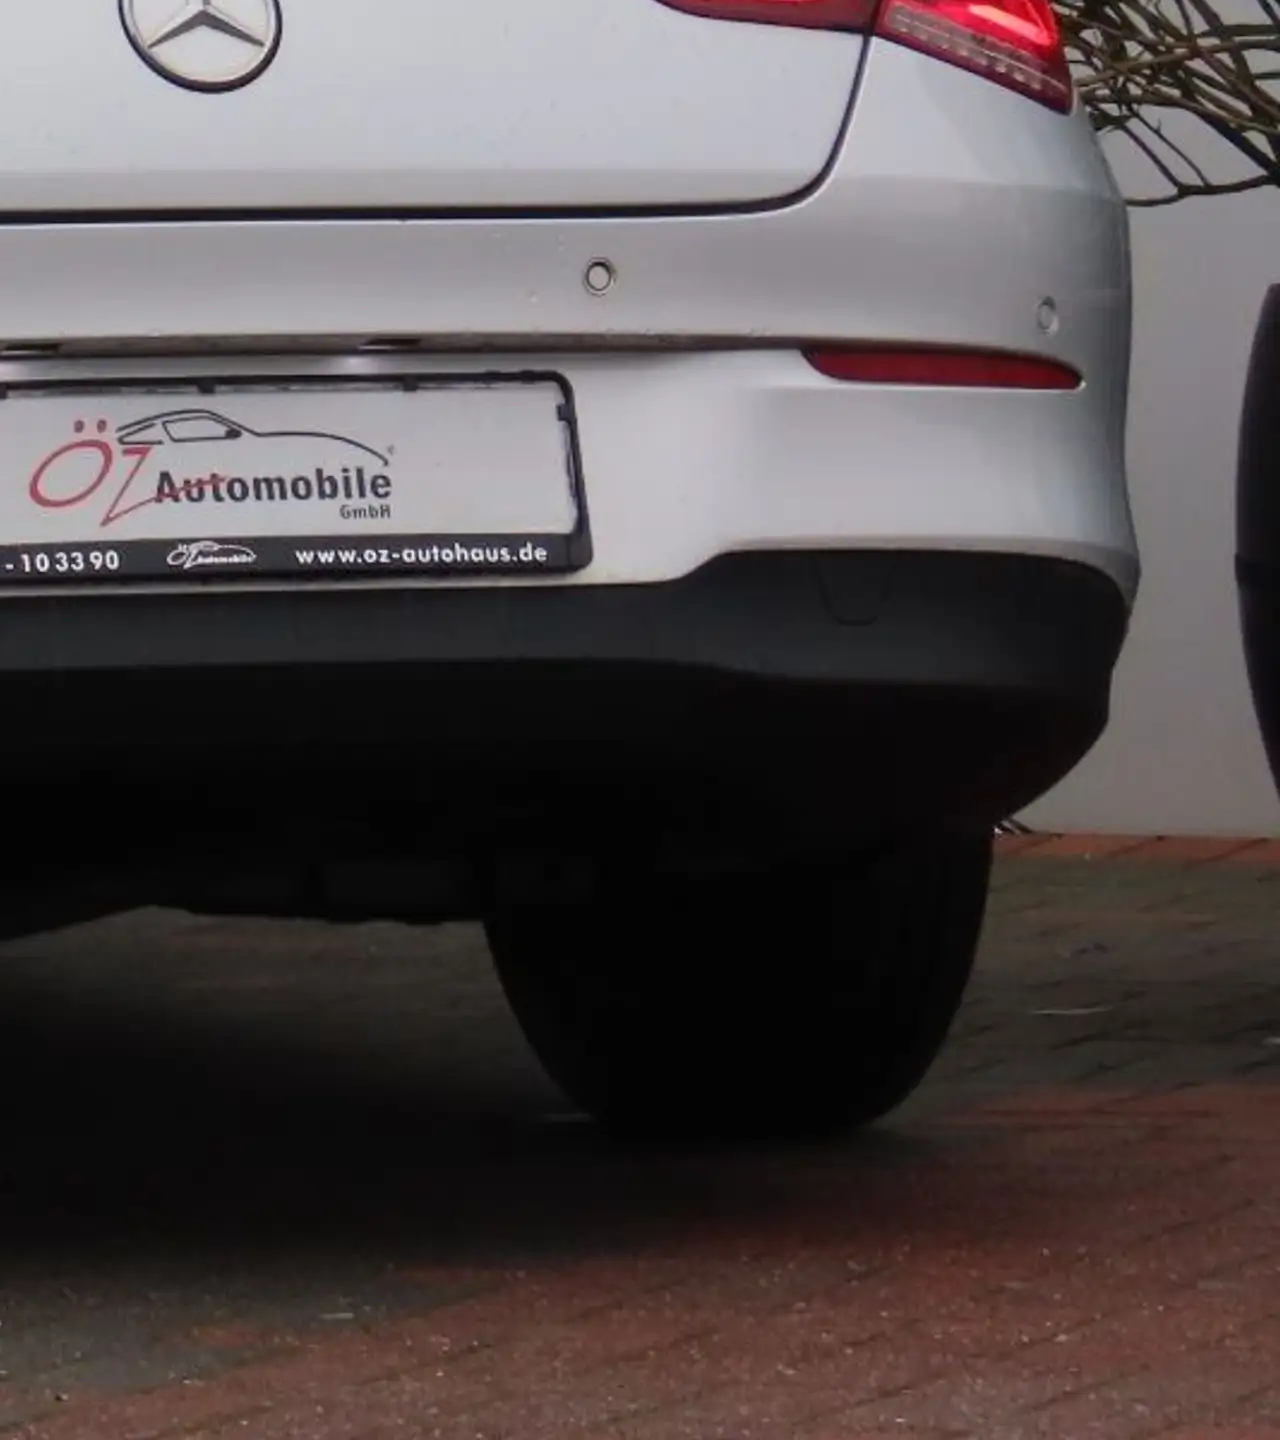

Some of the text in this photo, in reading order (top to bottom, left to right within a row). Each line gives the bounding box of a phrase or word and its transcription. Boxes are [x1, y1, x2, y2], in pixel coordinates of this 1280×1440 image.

[154, 464, 393, 504] Automobile
[339, 504, 393, 520] GmbH
[294, 541, 549, 565] www.oz-autohaus.de
